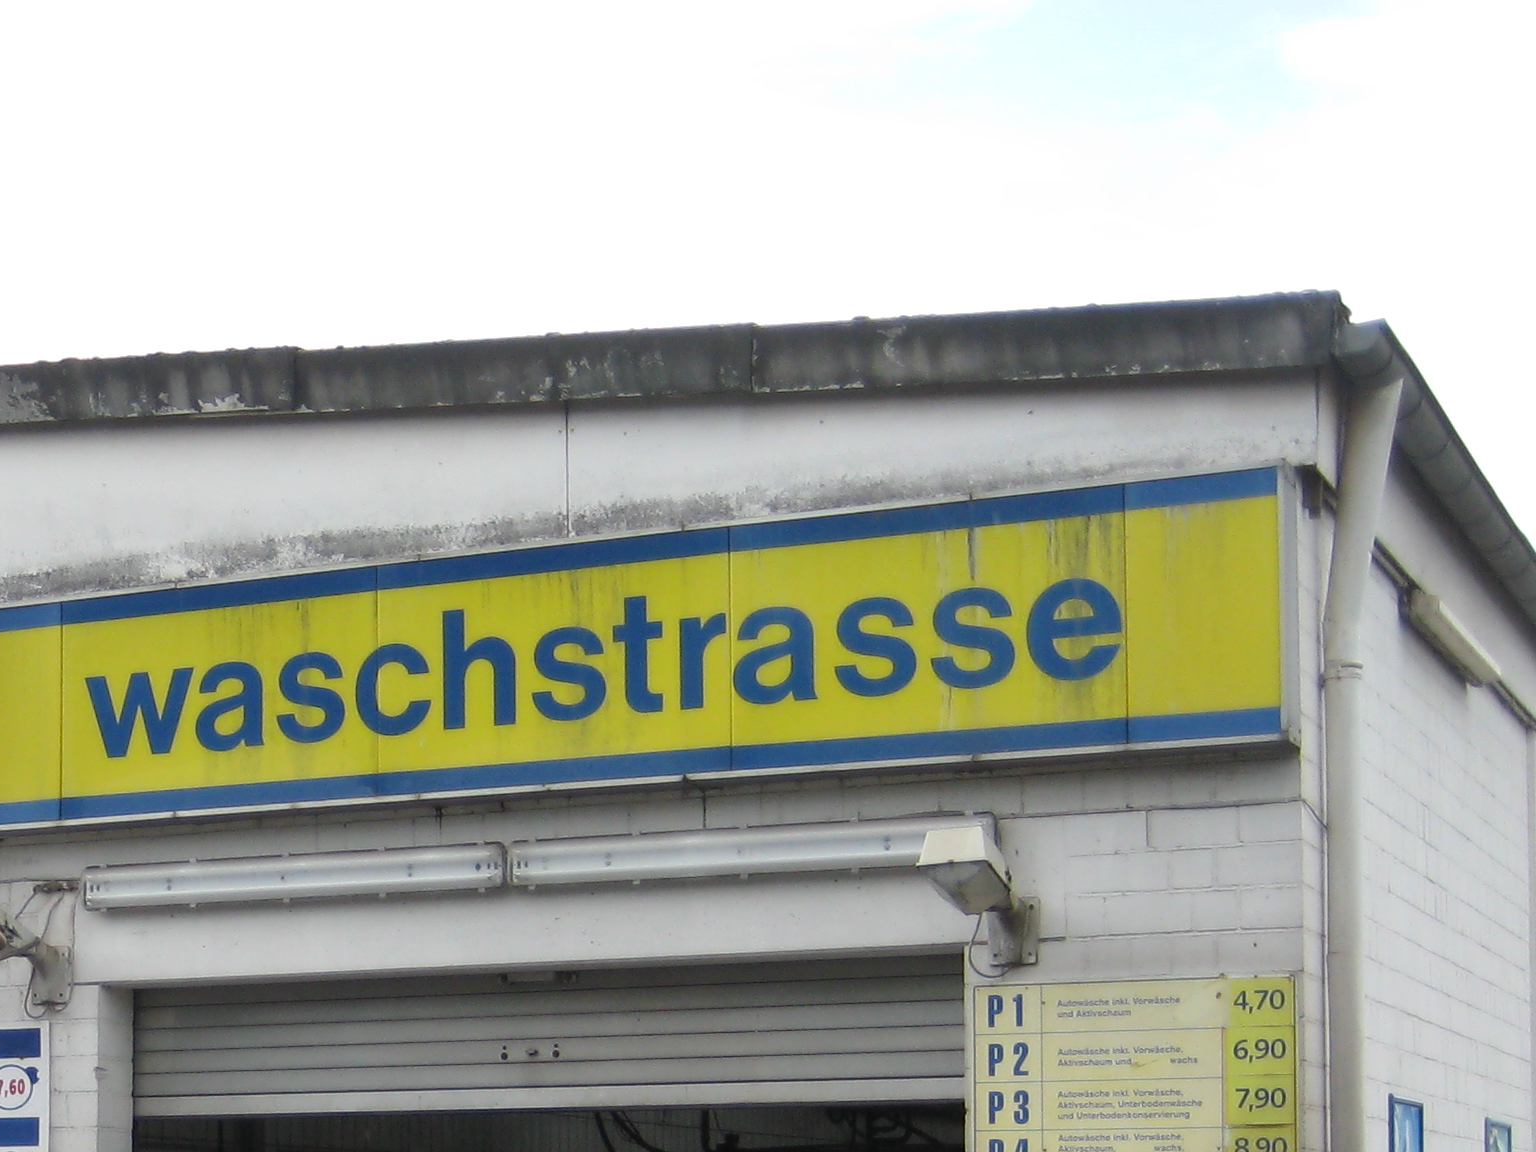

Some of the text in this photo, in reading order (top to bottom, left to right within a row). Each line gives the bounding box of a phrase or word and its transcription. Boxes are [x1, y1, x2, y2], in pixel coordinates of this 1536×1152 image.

[86, 577, 1123, 758] waschstrasse
[1057, 999, 1109, 1007] Autowäsche
[1133, 996, 1181, 1005] Vorwäsche
[1233, 989, 1285, 1014] 4,70
[1076, 1009, 1132, 1018] Aktivschaum
[1057, 1048, 1110, 1056] Autowäsche
[1233, 1038, 1286, 1063] 6,90
[1057, 1056, 1198, 1067] Aktivschaum und wachs
[1057, 1090, 1110, 1098] Autowäsche
[1118, 1100, 1203, 1108] Unterbodenwäsche
[1235, 1088, 1286, 1112] 7,90
[1057, 1111, 1190, 1120] und Unterbodenkonservierung
[1058, 1134, 1111, 1142] Autowäsche
